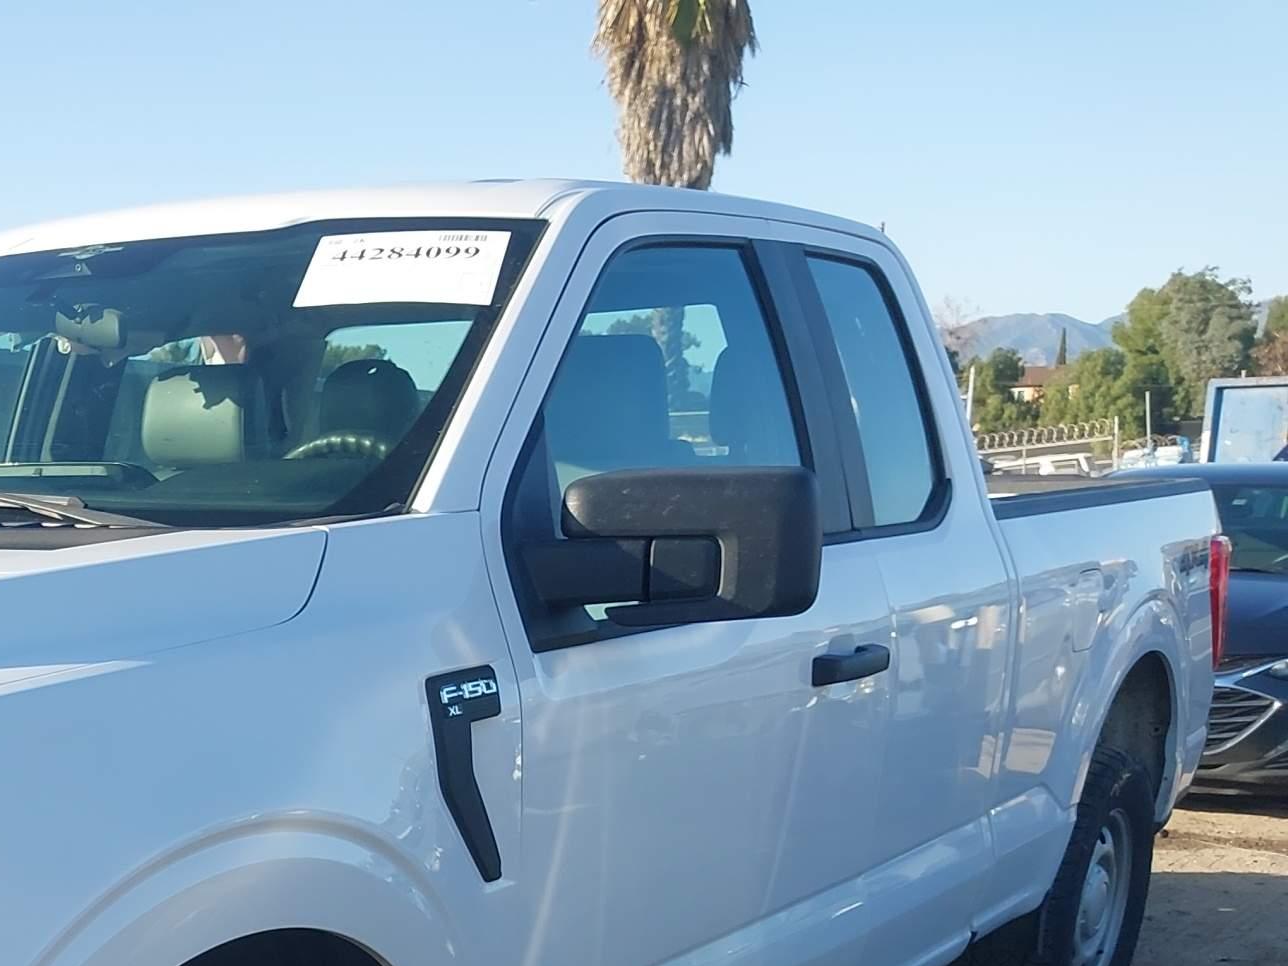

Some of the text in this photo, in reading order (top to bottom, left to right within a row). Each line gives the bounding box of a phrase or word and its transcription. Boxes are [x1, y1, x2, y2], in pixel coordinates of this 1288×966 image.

[331, 246, 481, 262] 44284099
[439, 678, 497, 704] F-150
[447, 705, 463, 717] XL
